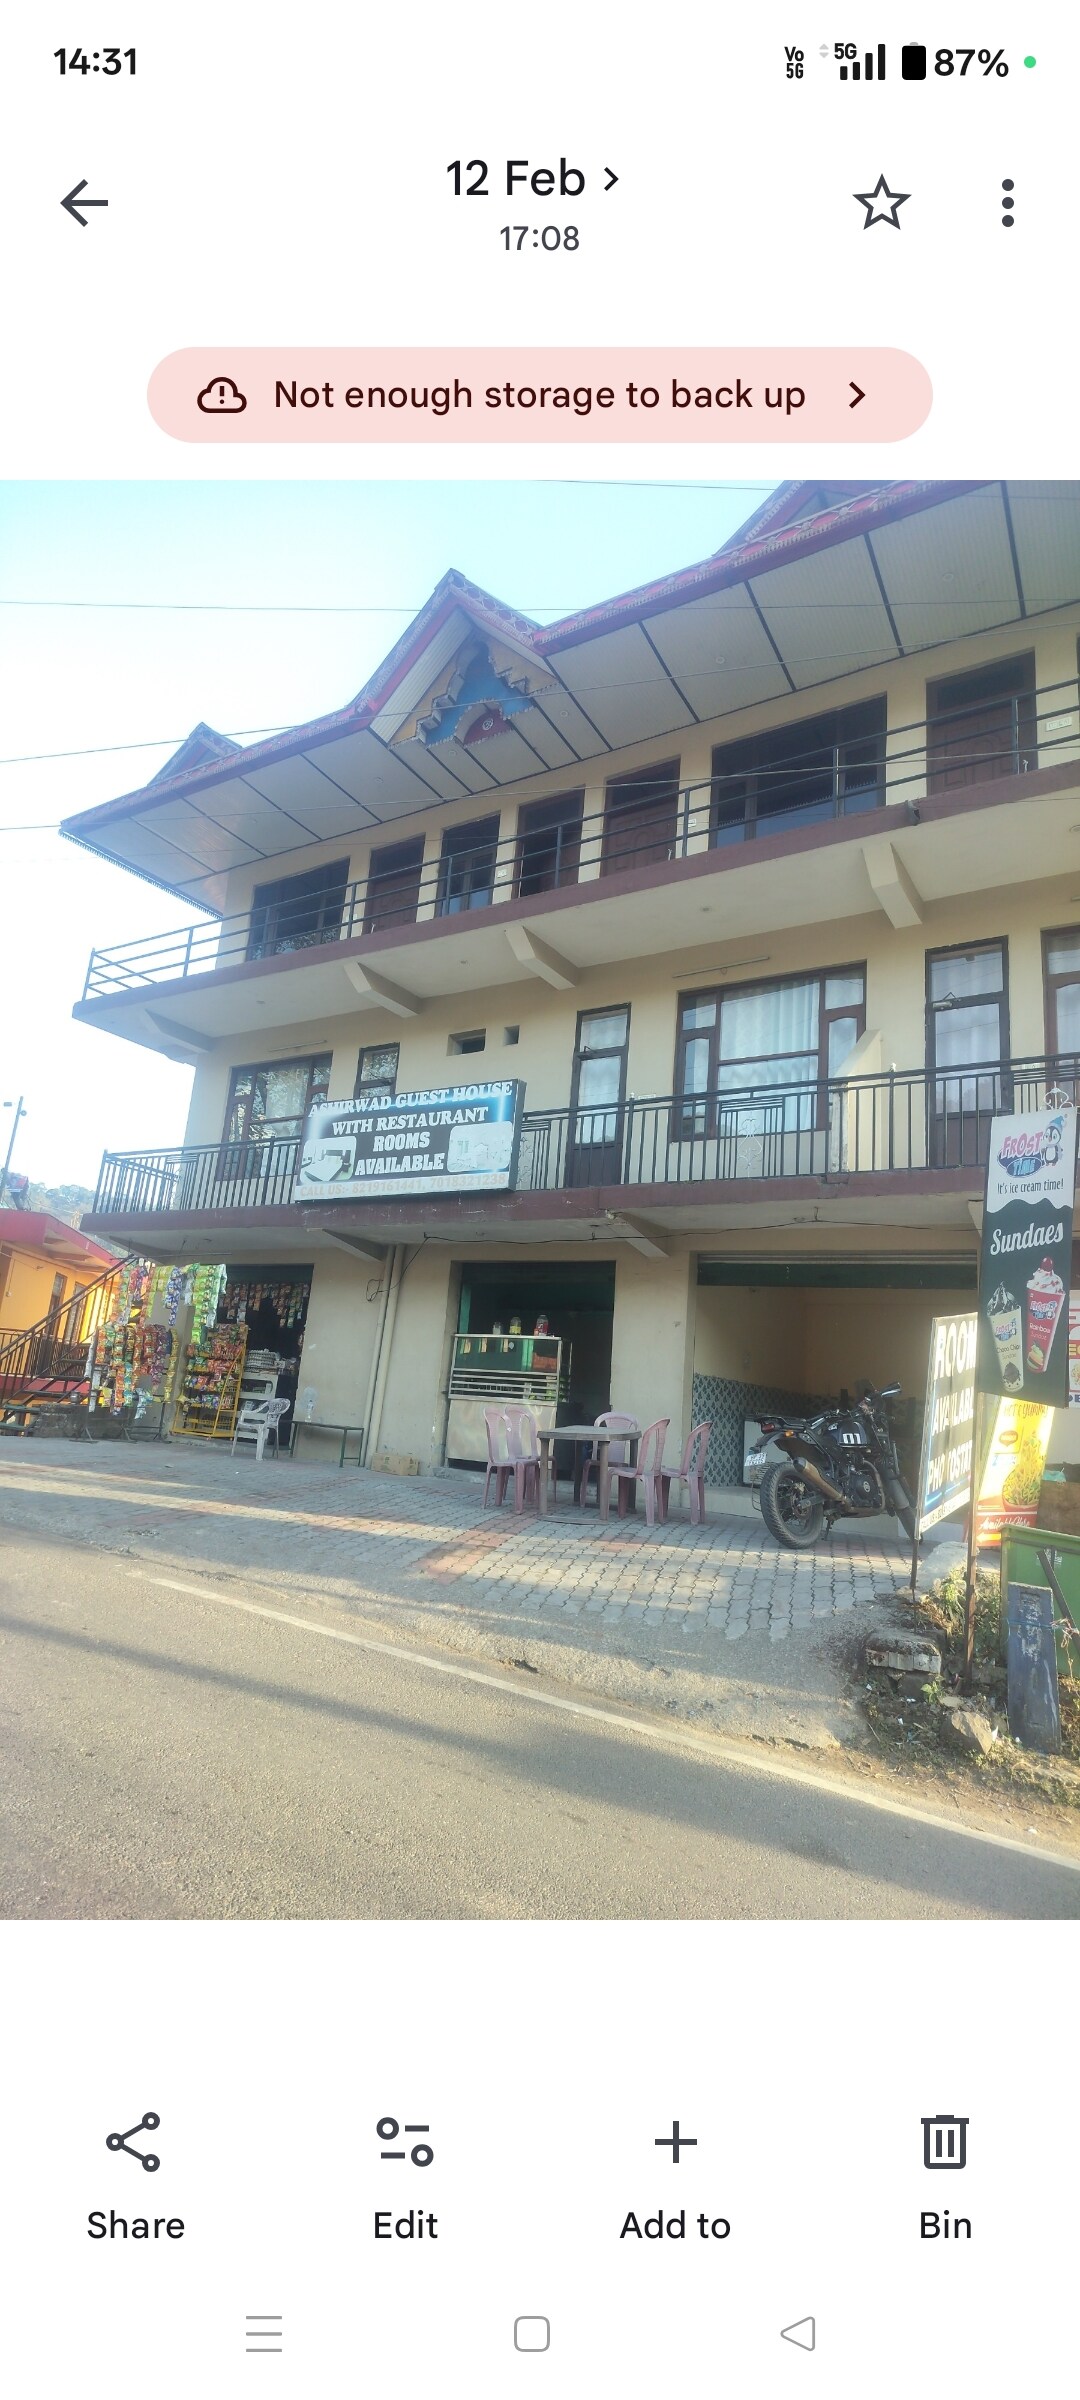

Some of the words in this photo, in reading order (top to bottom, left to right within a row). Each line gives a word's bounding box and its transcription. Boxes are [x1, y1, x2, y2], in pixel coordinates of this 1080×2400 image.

[308, 1096, 391, 1117] ASHIRWAD
[395, 1088, 450, 1108] GUEST
[451, 1081, 513, 1100] HOUSE
[332, 1117, 373, 1136] WITH
[376, 1107, 488, 1132] RESTAURANT
[373, 1132, 430, 1152] ROOMS
[1000, 1131, 1043, 1159] FROST
[354, 1153, 445, 1176] AVAILABLE
[301, 1186, 324, 1197] CALL
[997, 1182, 1008, 1195] It's
[1010, 1182, 1019, 1193] ice
[1021, 1181, 1042, 1193] cream
[1044, 1178, 1064, 1191] time!
[990, 1222, 1064, 1255] Sundaes
